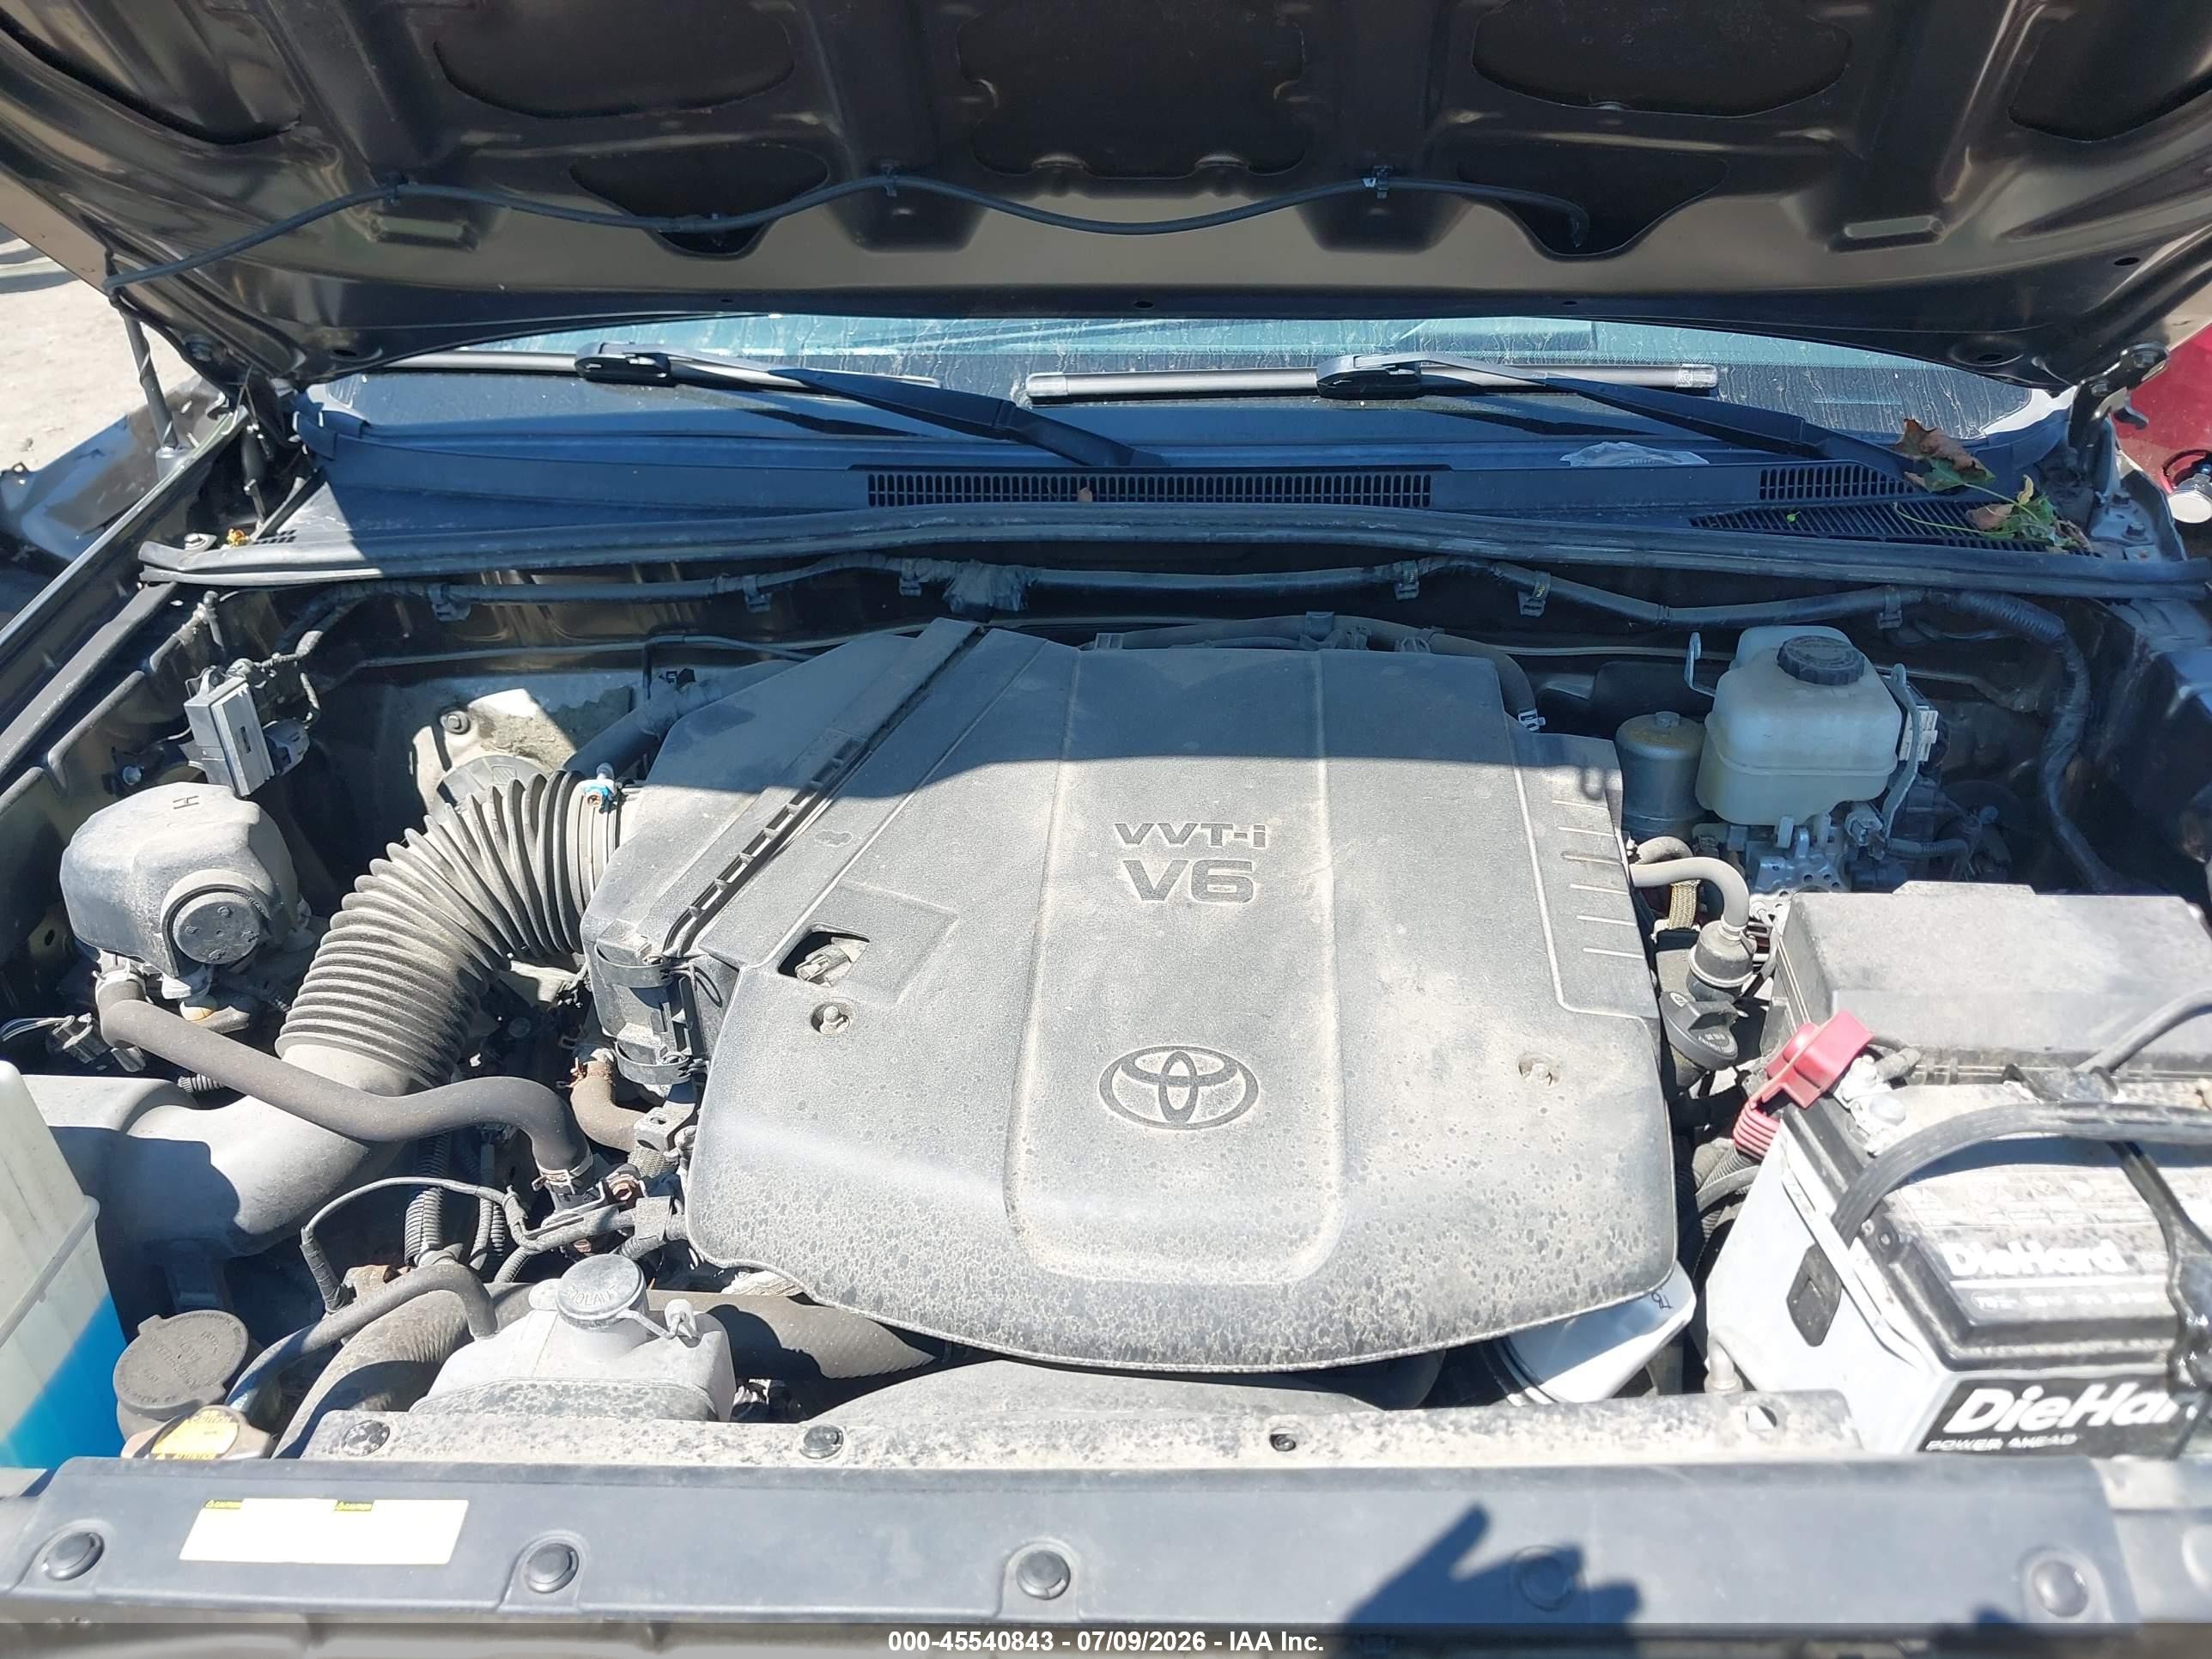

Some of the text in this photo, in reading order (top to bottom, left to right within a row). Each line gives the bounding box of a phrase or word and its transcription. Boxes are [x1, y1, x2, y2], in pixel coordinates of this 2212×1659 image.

[1114, 822, 1267, 848] VVT-i
[1121, 859, 1256, 904] V6
[1938, 1238, 2128, 1276] DieHard
[1925, 1437, 2003, 1452] POWER
